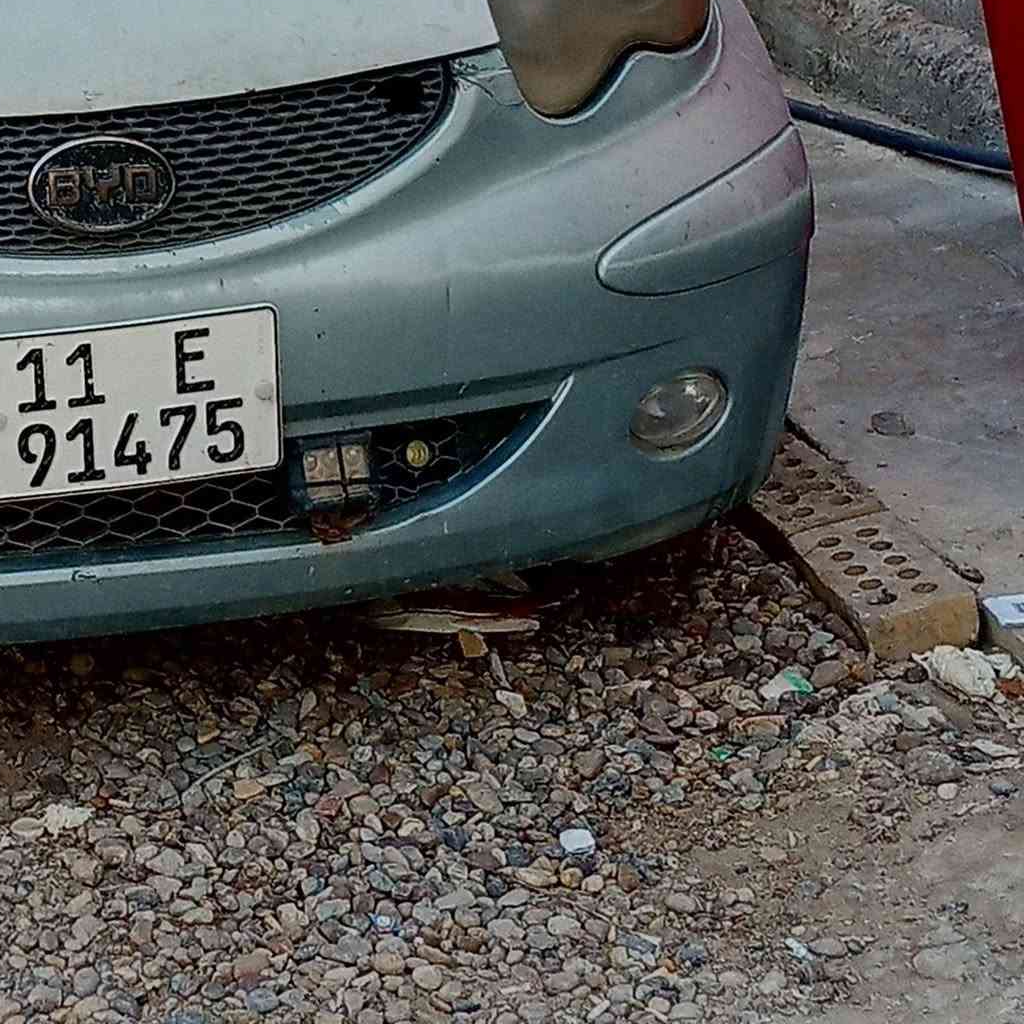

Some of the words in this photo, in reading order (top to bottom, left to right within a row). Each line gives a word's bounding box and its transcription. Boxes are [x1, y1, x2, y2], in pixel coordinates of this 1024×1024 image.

[16, 343, 106, 414] 11
[174, 327, 216, 394] E
[17, 397, 245, 487] 91475
